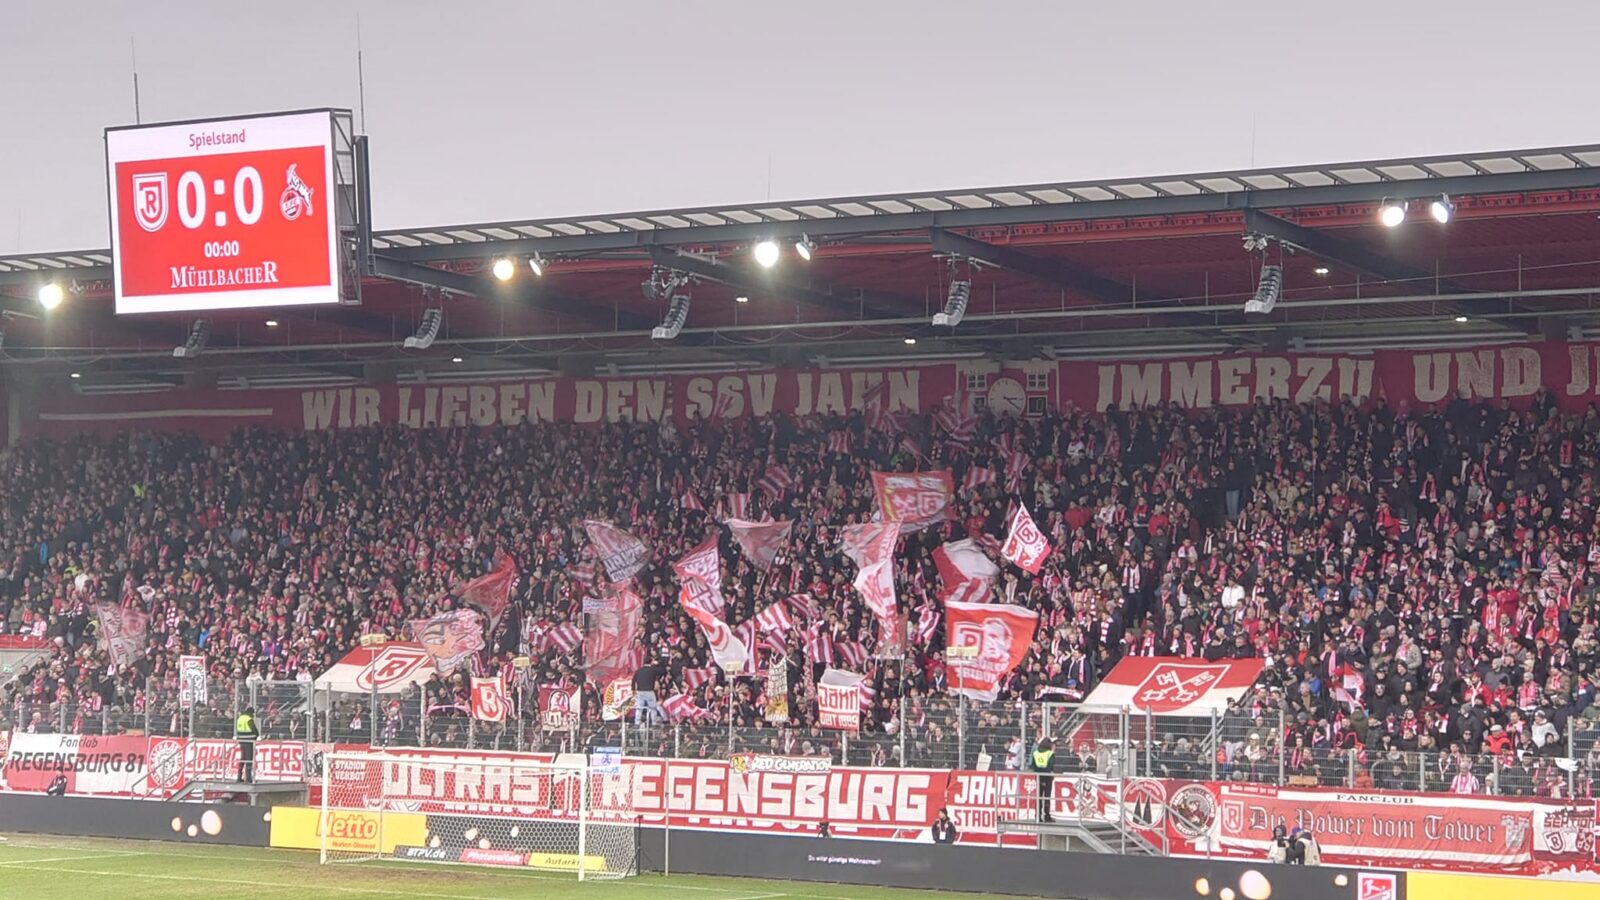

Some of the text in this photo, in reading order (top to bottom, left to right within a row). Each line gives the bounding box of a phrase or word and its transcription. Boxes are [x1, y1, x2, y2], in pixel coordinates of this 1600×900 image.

[189, 129, 246, 150] Spielstand
[177, 166, 264, 229] 0:0
[204, 240, 239, 257] 00:00
[170, 261, 279, 288] MÜHLBACHER
[301, 344, 1600, 430] WIR LIEBEN DEN SSV JAHN IMMERZU UND J
[59, 735, 98, 749] Fanclub
[9, 750, 122, 774] REGENSBURG
[125, 752, 144, 773] 81
[383, 753, 540, 802] ULTRAS
[600, 762, 931, 823] REGENSBURG
[954, 775, 1018, 806] JAHN
[1336, 794, 1415, 804] FANCLUB
[316, 812, 378, 840] Netto
[1248, 805, 1286, 831] Die
[1295, 808, 1366, 837] Power
[1372, 813, 1416, 839] vom
[1424, 813, 1498, 843] Tower
